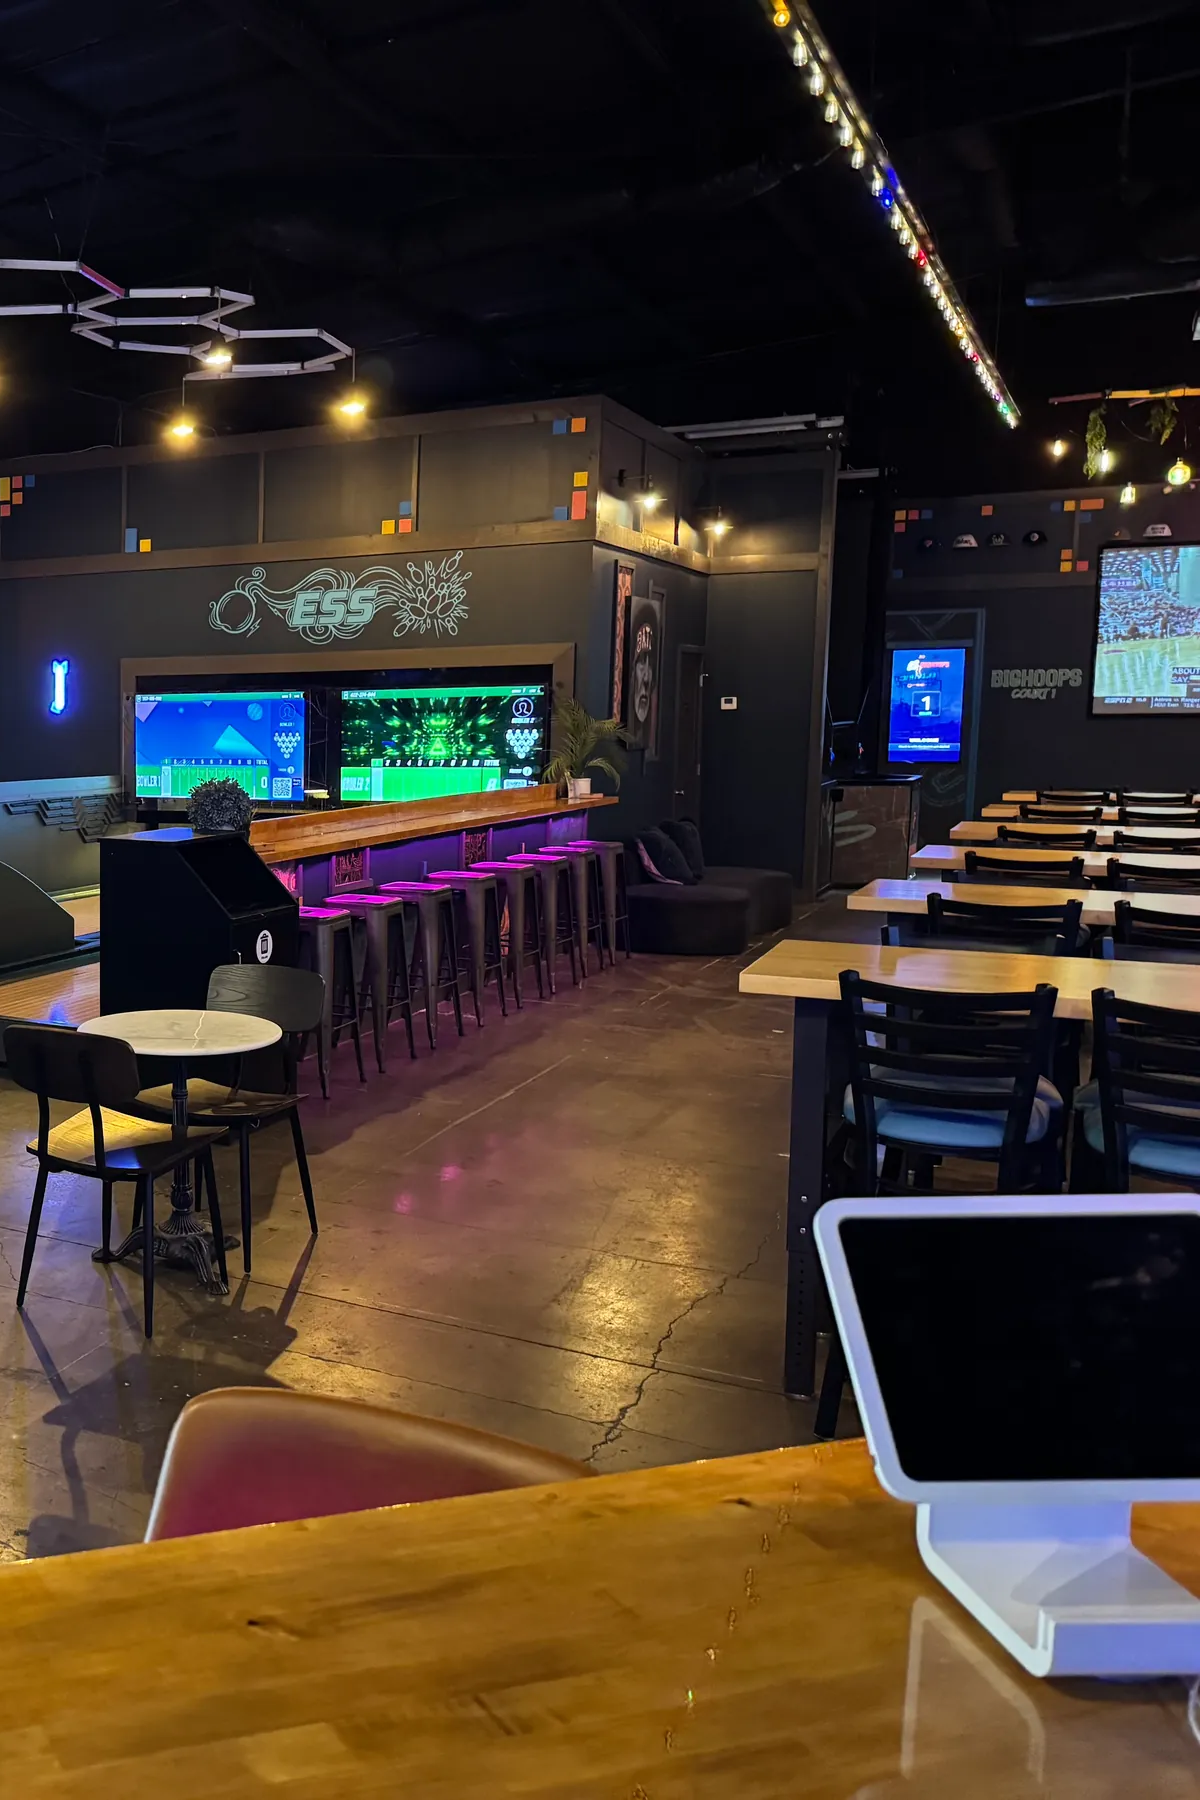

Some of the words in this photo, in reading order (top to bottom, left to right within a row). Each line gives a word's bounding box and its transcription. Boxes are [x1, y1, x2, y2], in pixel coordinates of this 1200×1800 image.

[289, 586, 379, 627] ESS
[990, 668, 1083, 688] BIGHOOPS
[1011, 688, 1050, 700] COURT
[1051, 688, 1057, 699] 1
[921, 695, 931, 711] 1
[137, 775, 158, 787] BOWLER
[261, 776, 268, 789] 0
